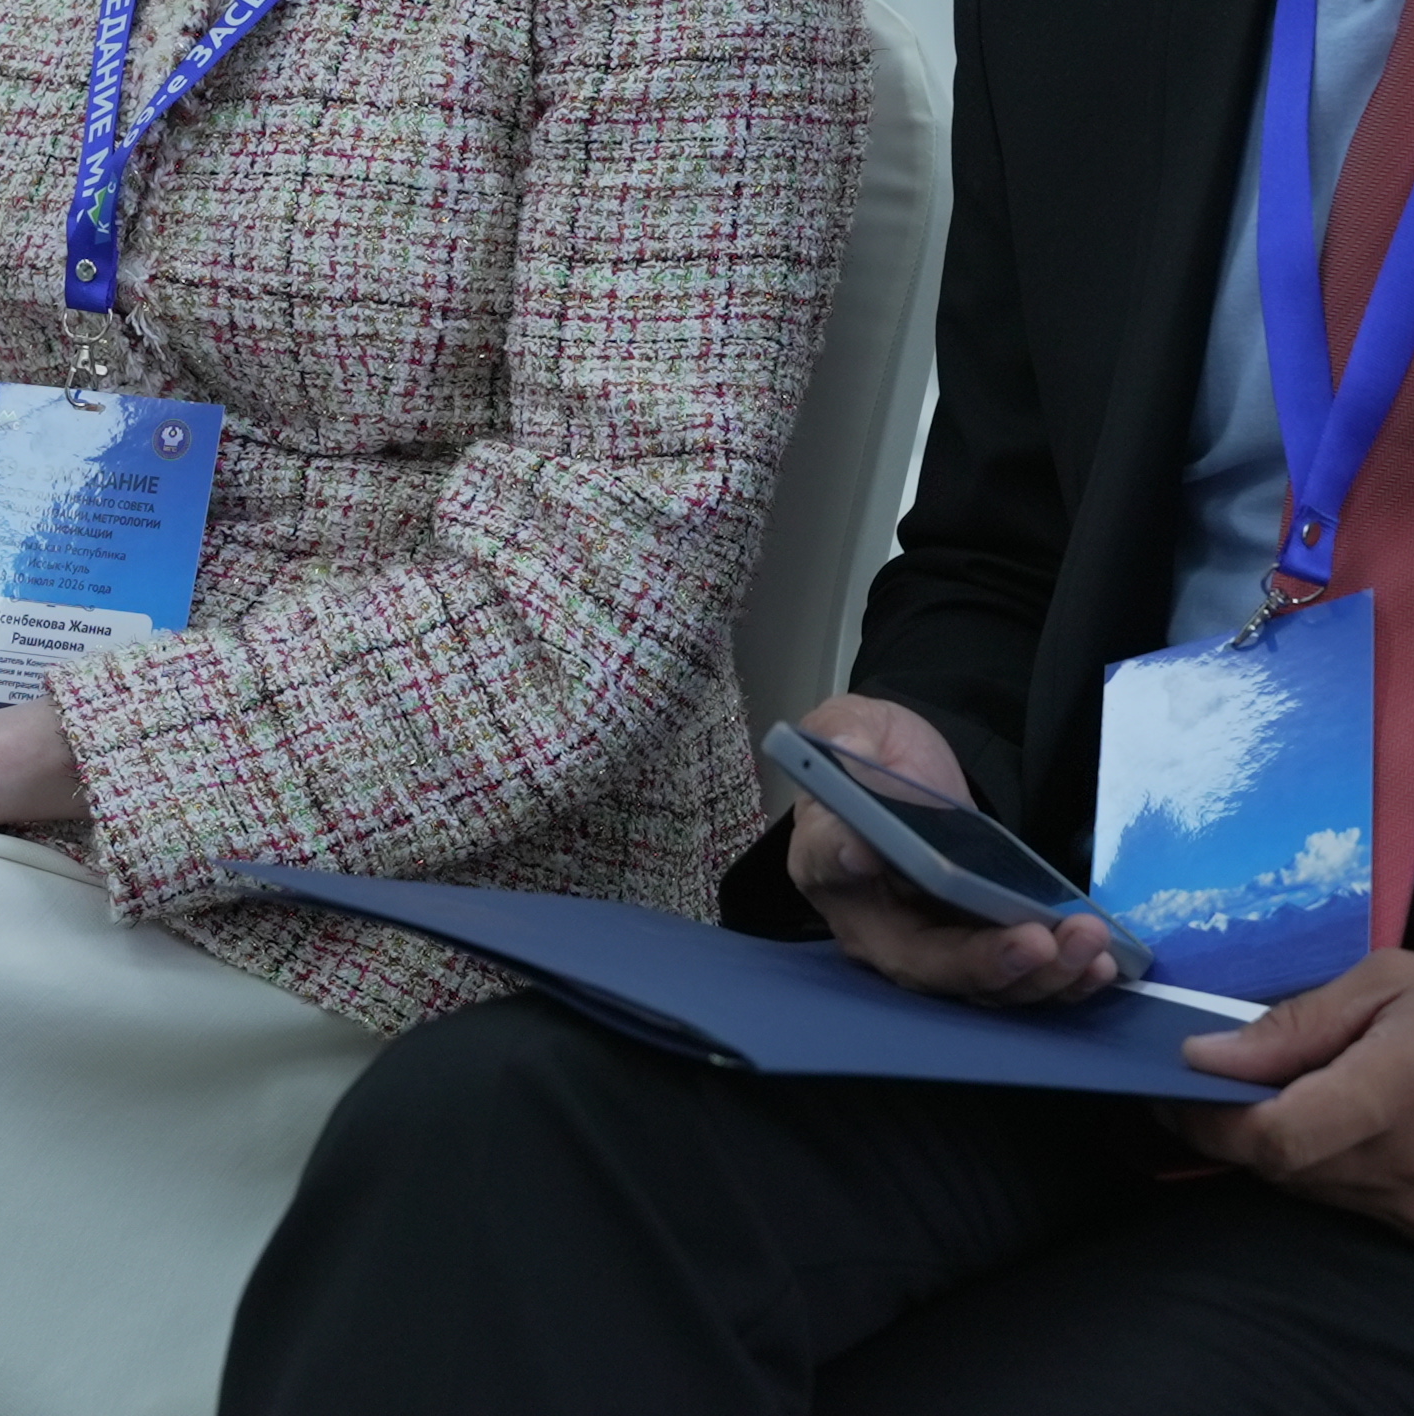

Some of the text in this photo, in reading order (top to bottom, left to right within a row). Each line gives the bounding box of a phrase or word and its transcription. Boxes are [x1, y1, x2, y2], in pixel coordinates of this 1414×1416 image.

[117, 499, 155, 514] СОВЕТА
[92, 513, 162, 530] МЕТРОЛОГИИ
[65, 543, 127, 562] Республика
[27, 556, 90, 575] Иссык-Куль
[27, 576, 55, 587] июля
[57, 577, 85, 591] 2026
[87, 582, 112, 595] года
[69, 619, 113, 636] Жанна
[11, 632, 85, 653] Рашидовна
